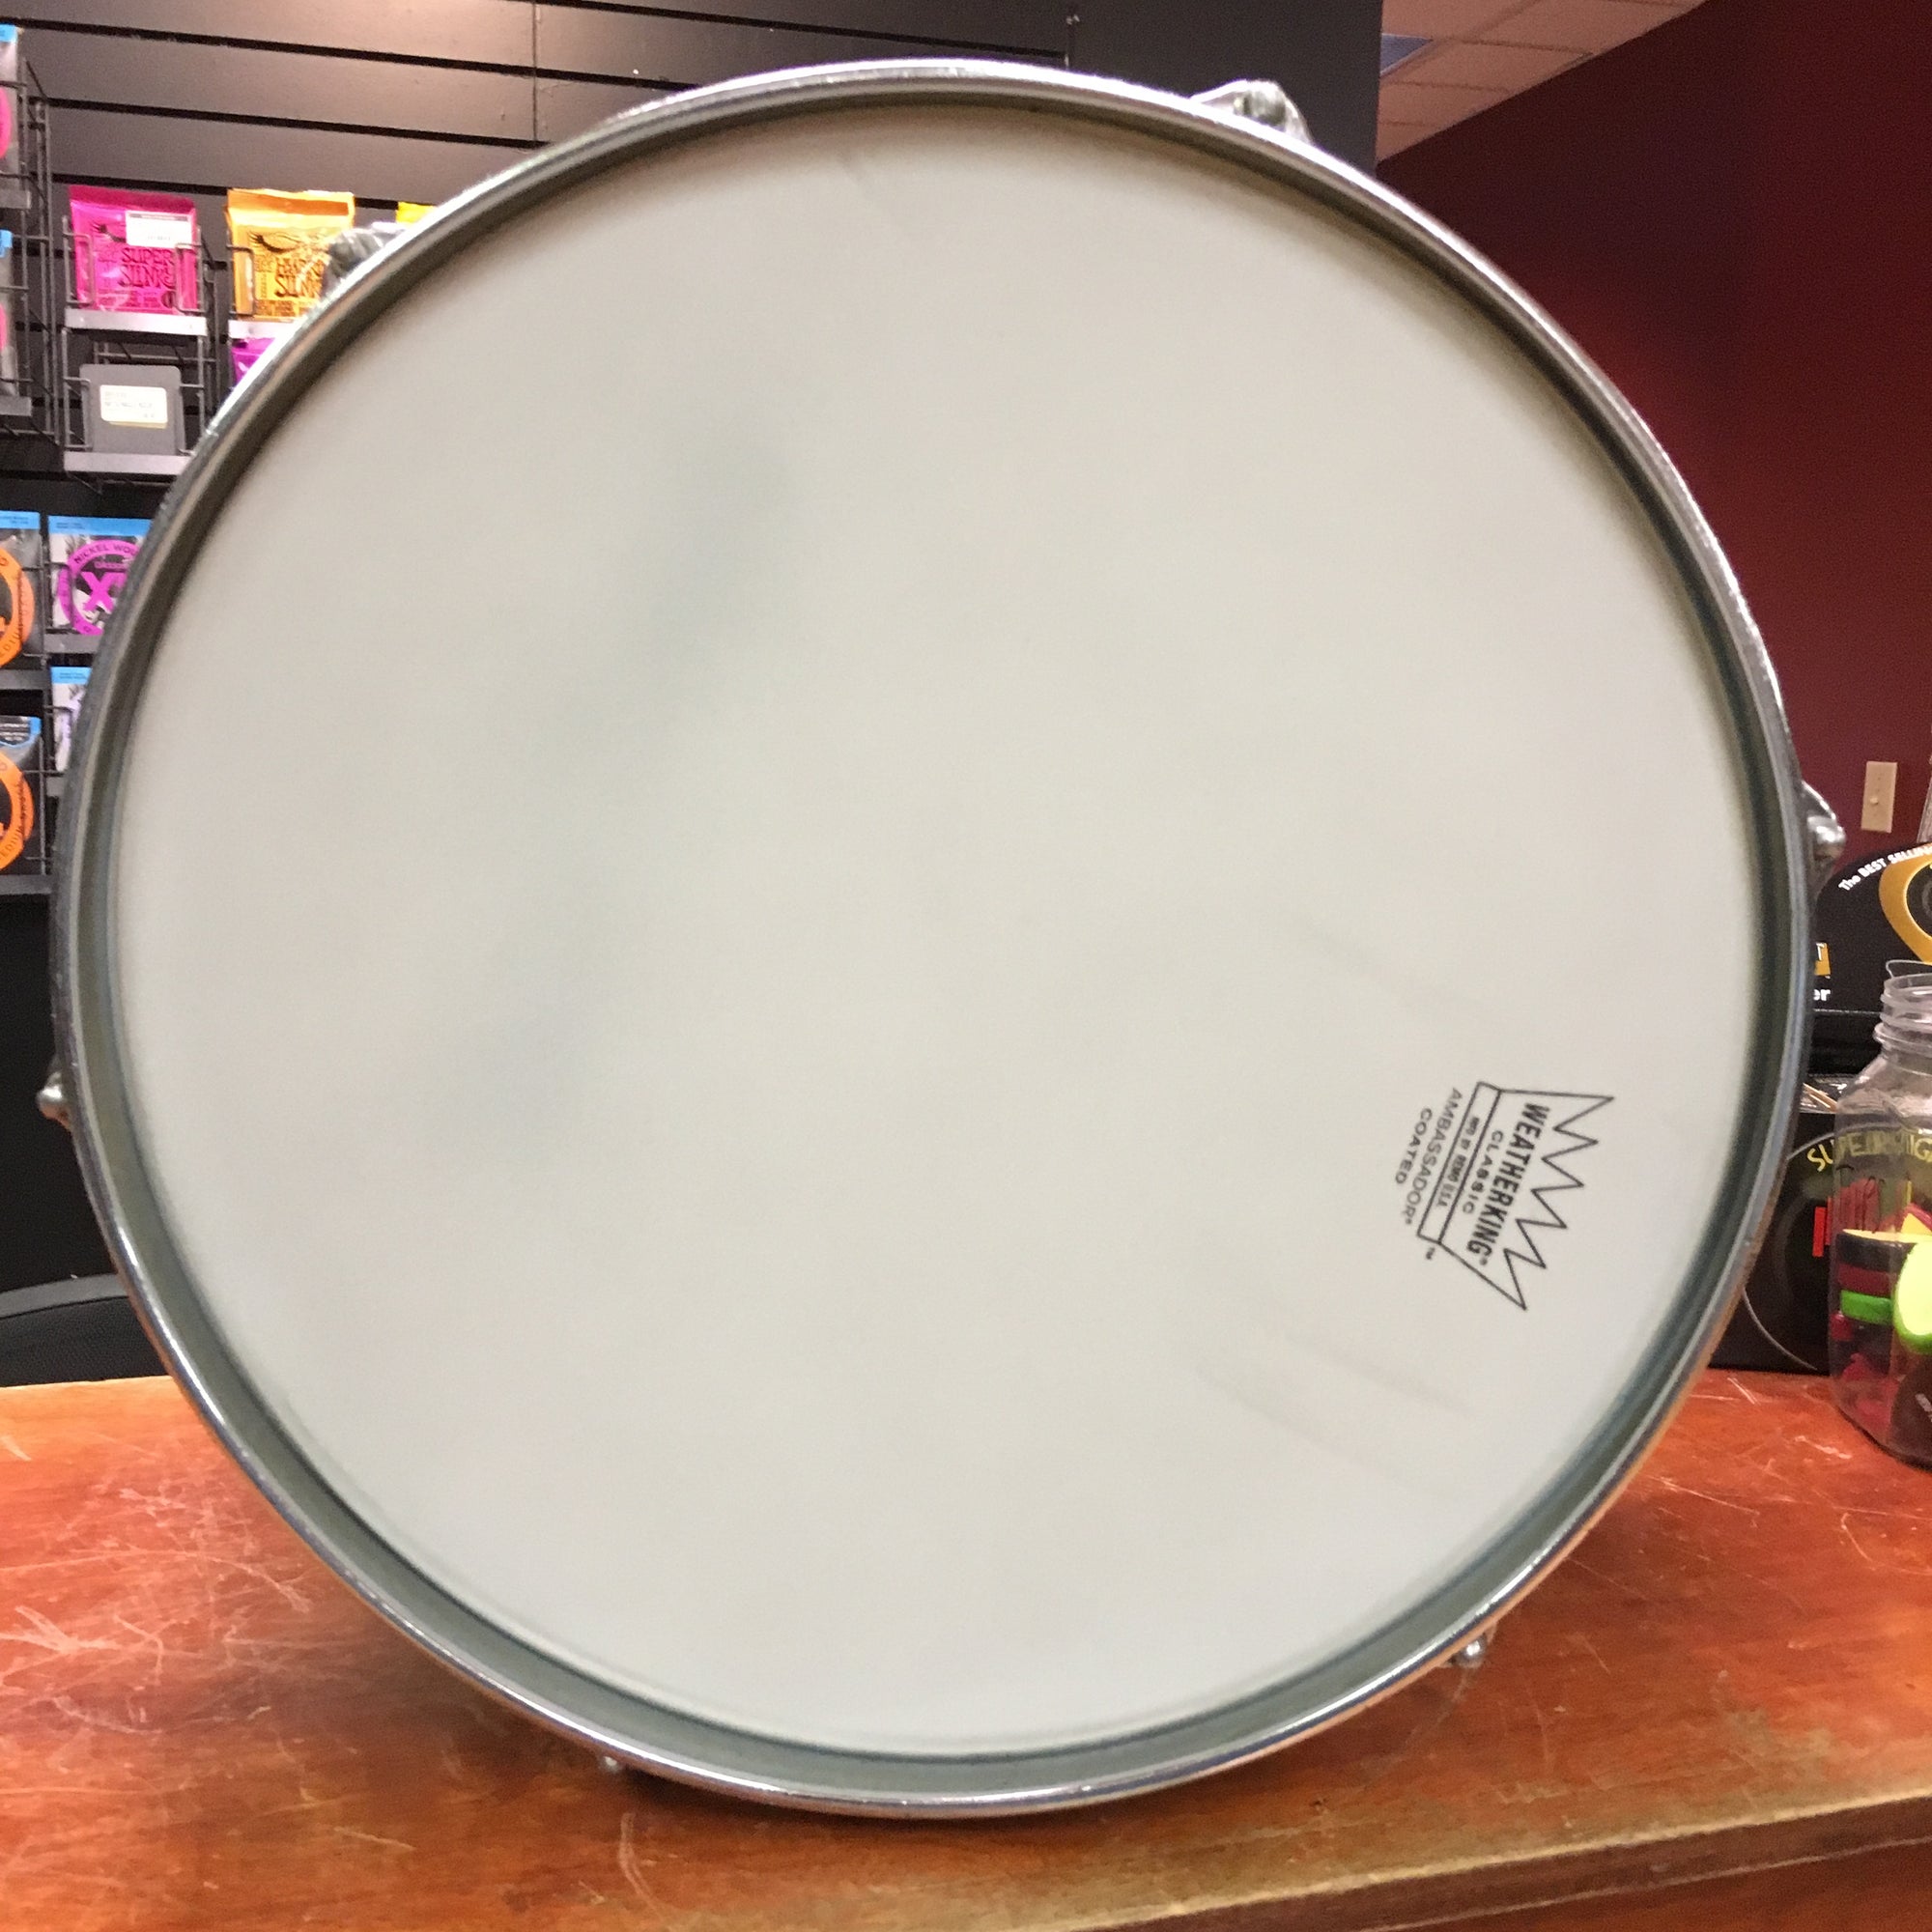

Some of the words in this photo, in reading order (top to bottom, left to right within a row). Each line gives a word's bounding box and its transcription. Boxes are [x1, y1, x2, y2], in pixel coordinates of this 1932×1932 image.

[122, 246, 175, 266] SUPER
[117, 264, 176, 290] SLINKY
[73, 543, 109, 564] NICKEL
[1838, 876, 1861, 891] The
[1858, 857, 1887, 878] BEST
[1395, 1107, 1433, 1184] COATED
[1403, 1087, 1463, 1221] AMBASSADOR
[1446, 1152, 1467, 1183] REMO
[1463, 1129, 1505, 1214] CLASSIC
[1466, 1101, 1551, 1260] WEATHERKING
